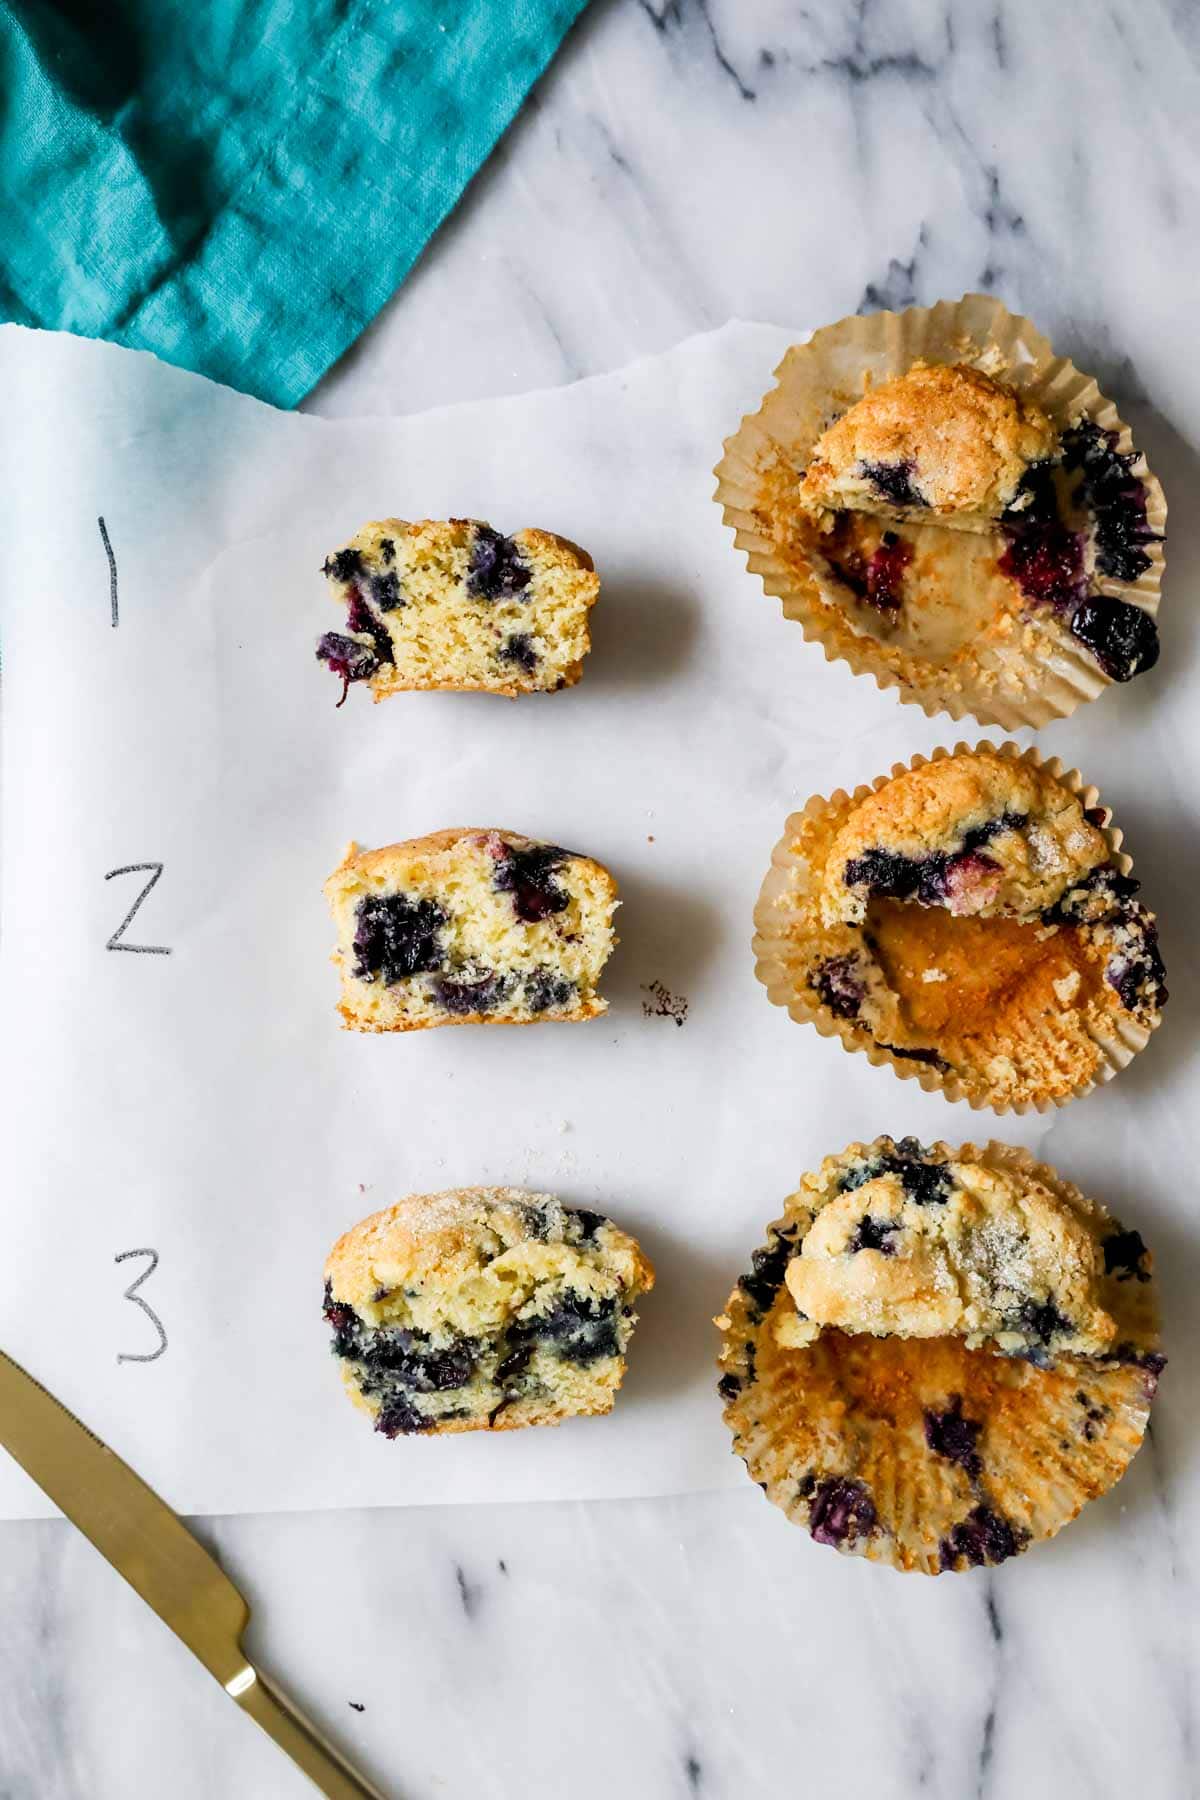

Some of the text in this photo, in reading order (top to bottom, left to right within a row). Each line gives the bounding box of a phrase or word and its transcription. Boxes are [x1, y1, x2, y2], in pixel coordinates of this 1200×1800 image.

[97, 515, 120, 628] 1
[104, 861, 172, 956] 2
[114, 1247, 169, 1365] 3
